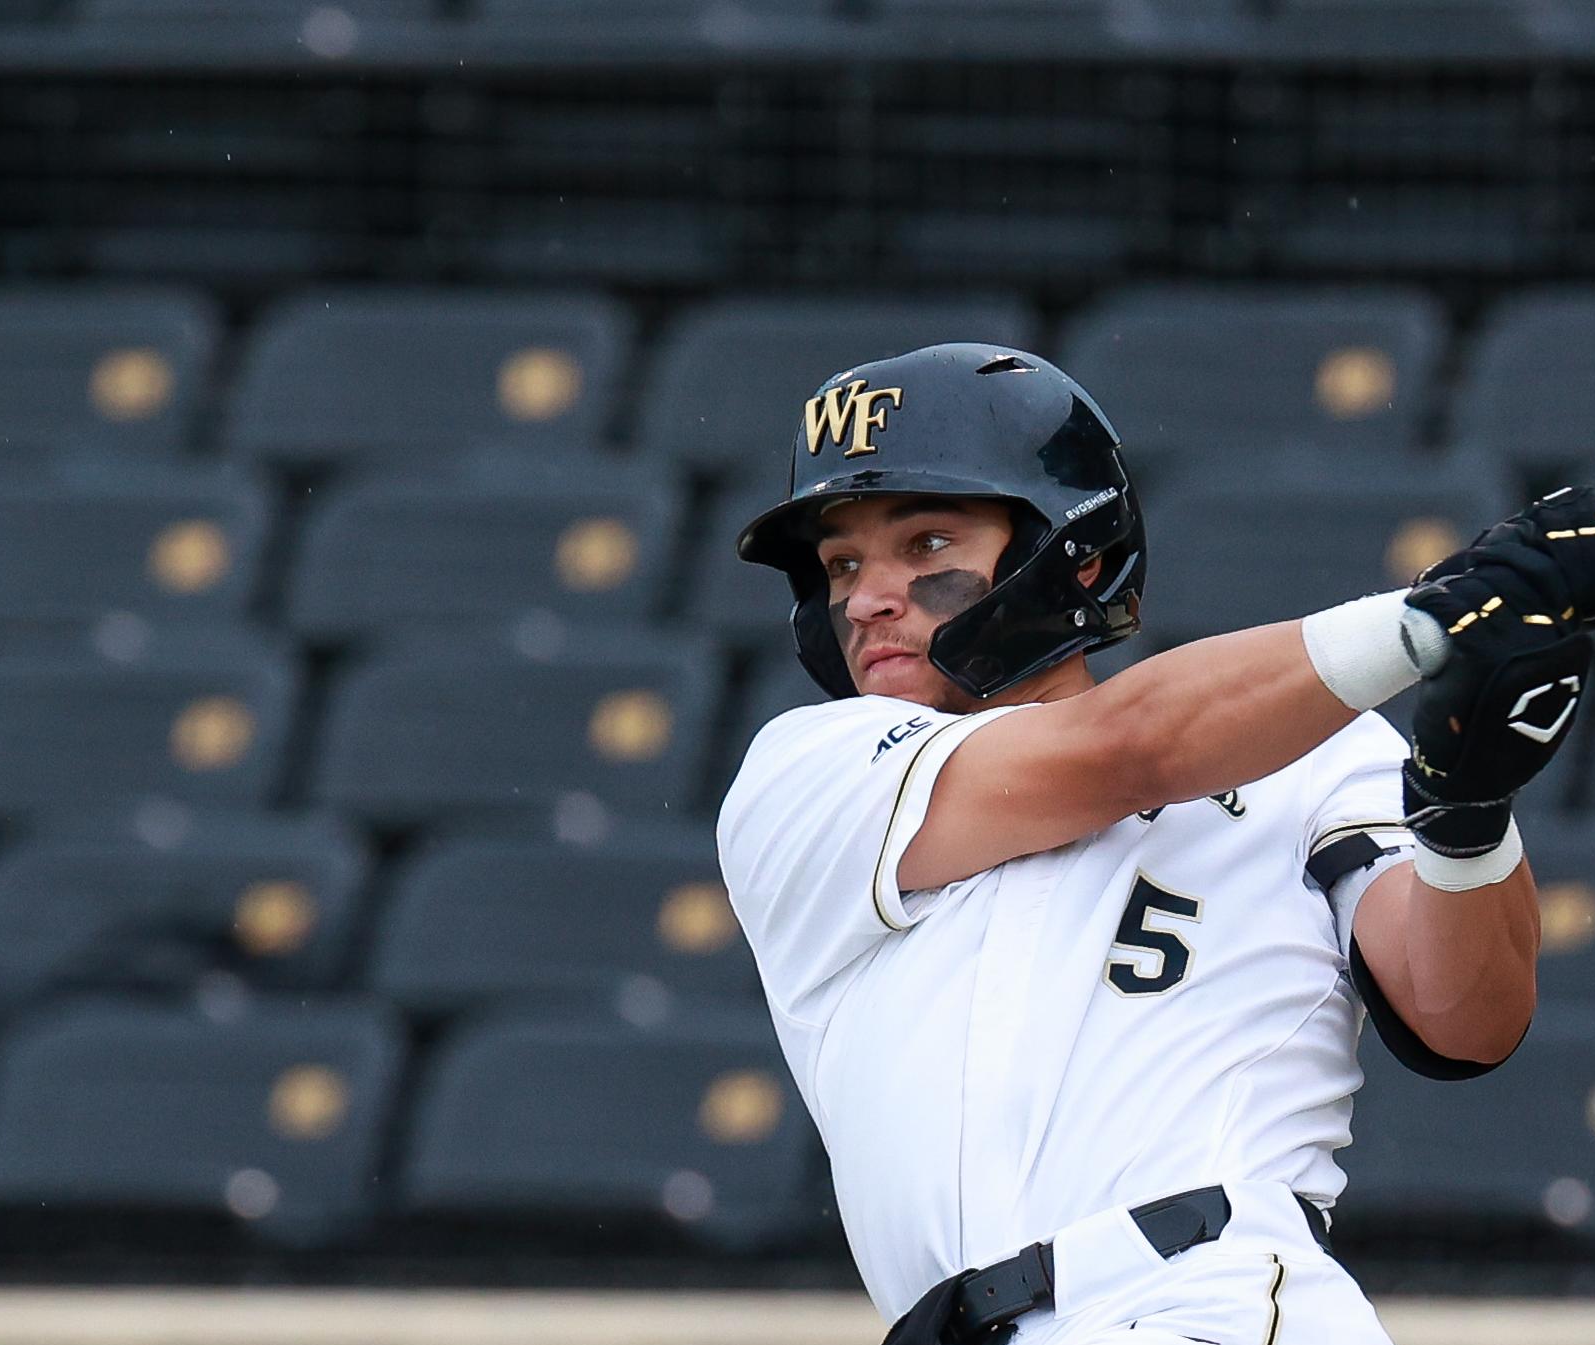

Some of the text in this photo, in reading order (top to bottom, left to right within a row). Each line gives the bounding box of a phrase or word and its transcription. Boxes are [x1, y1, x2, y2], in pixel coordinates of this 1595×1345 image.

[804, 378, 904, 458] WF
[870, 715, 932, 767] ACC
[1103, 867, 1204, 998] 5
